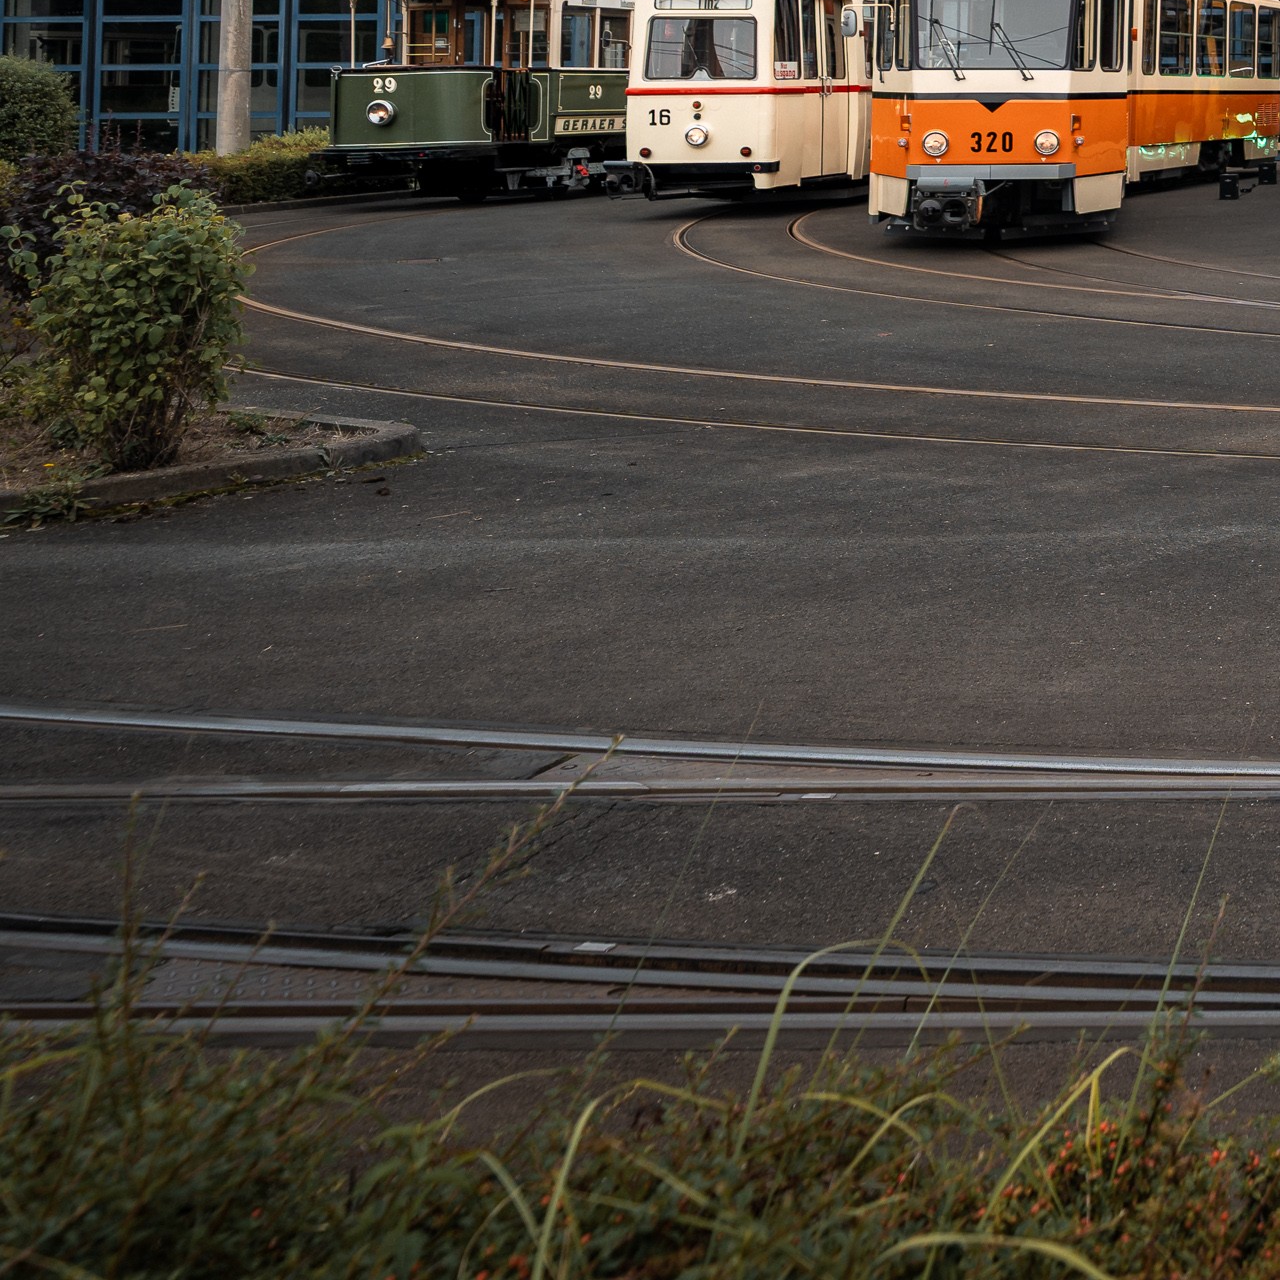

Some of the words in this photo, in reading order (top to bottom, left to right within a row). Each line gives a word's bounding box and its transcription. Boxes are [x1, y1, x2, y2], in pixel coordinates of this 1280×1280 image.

[373, 77, 397, 93] 29
[588, 84, 602, 99] 29
[562, 118, 615, 131] GERAER
[648, 109, 671, 126] 16
[970, 131, 1013, 153] 320
